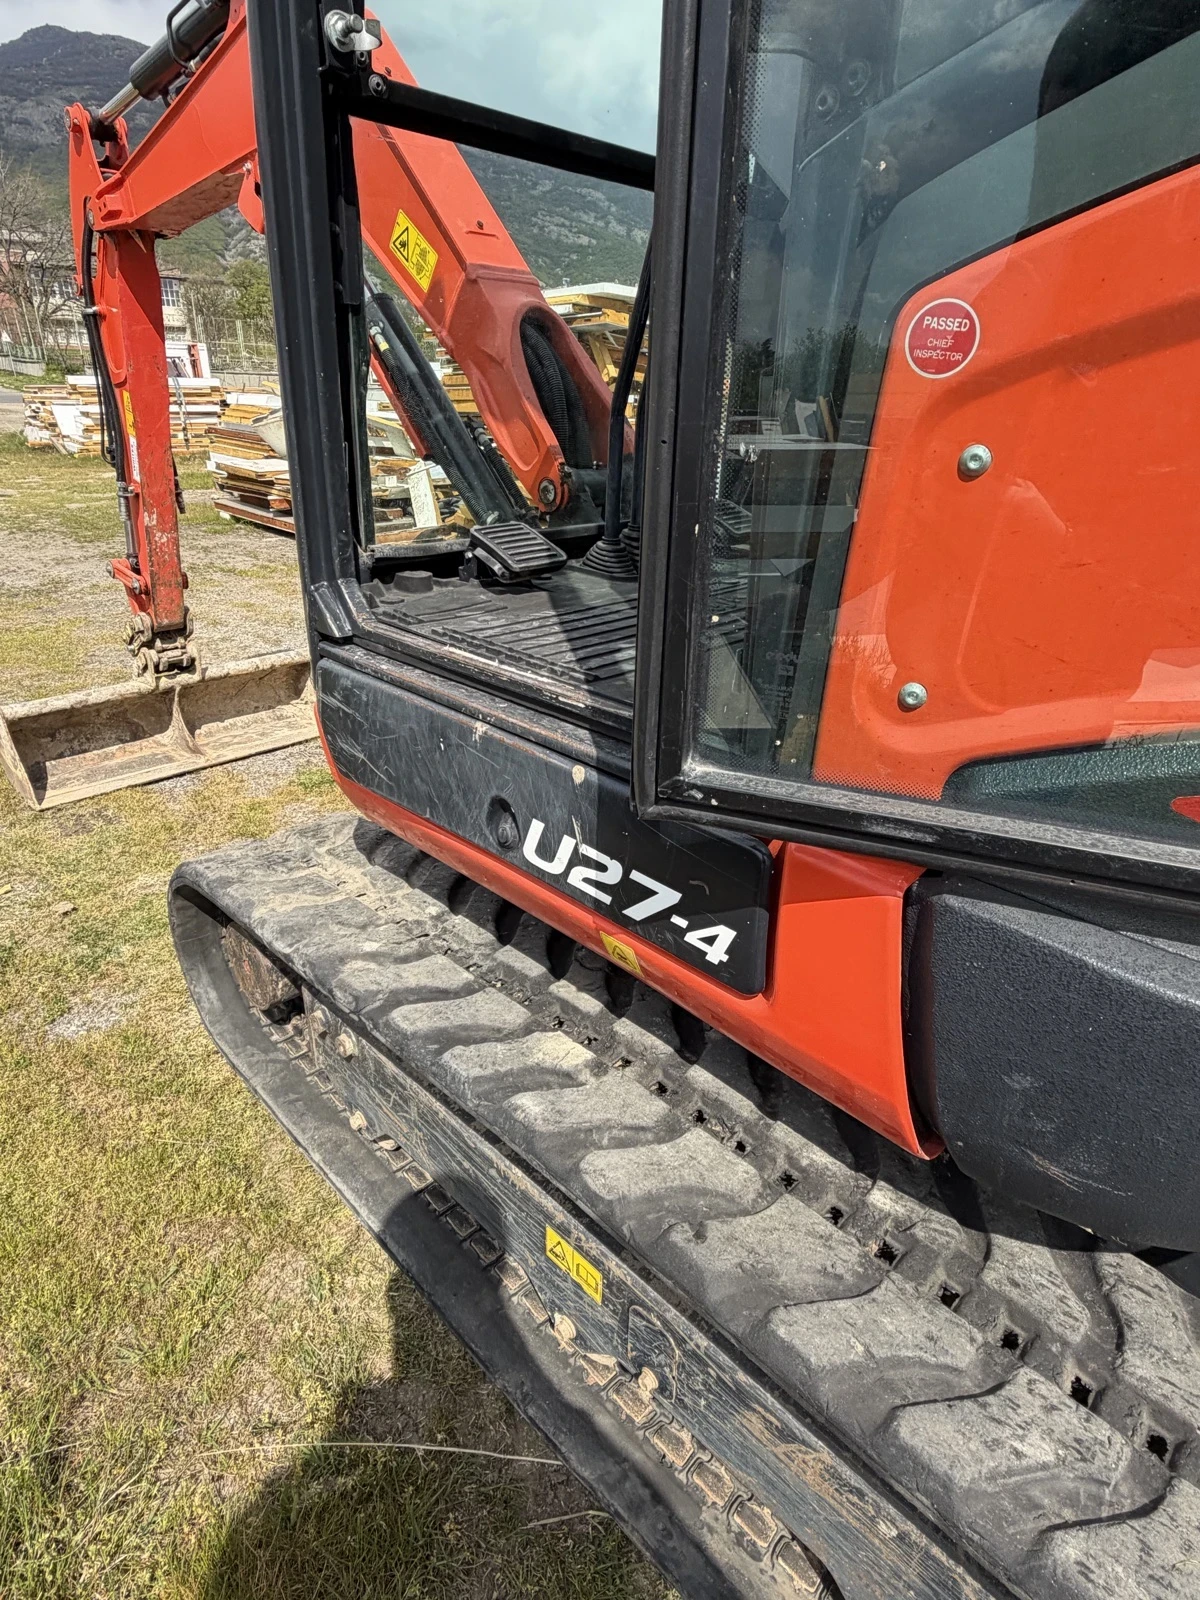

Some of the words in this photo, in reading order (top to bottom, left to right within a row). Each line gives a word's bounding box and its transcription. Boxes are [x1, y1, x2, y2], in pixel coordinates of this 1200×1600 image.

[923, 316, 970, 331] PASSED
[927, 338, 954, 348] CHIEF
[913, 349, 963, 361] INSPECTOR
[522, 818, 737, 965] U27-4
